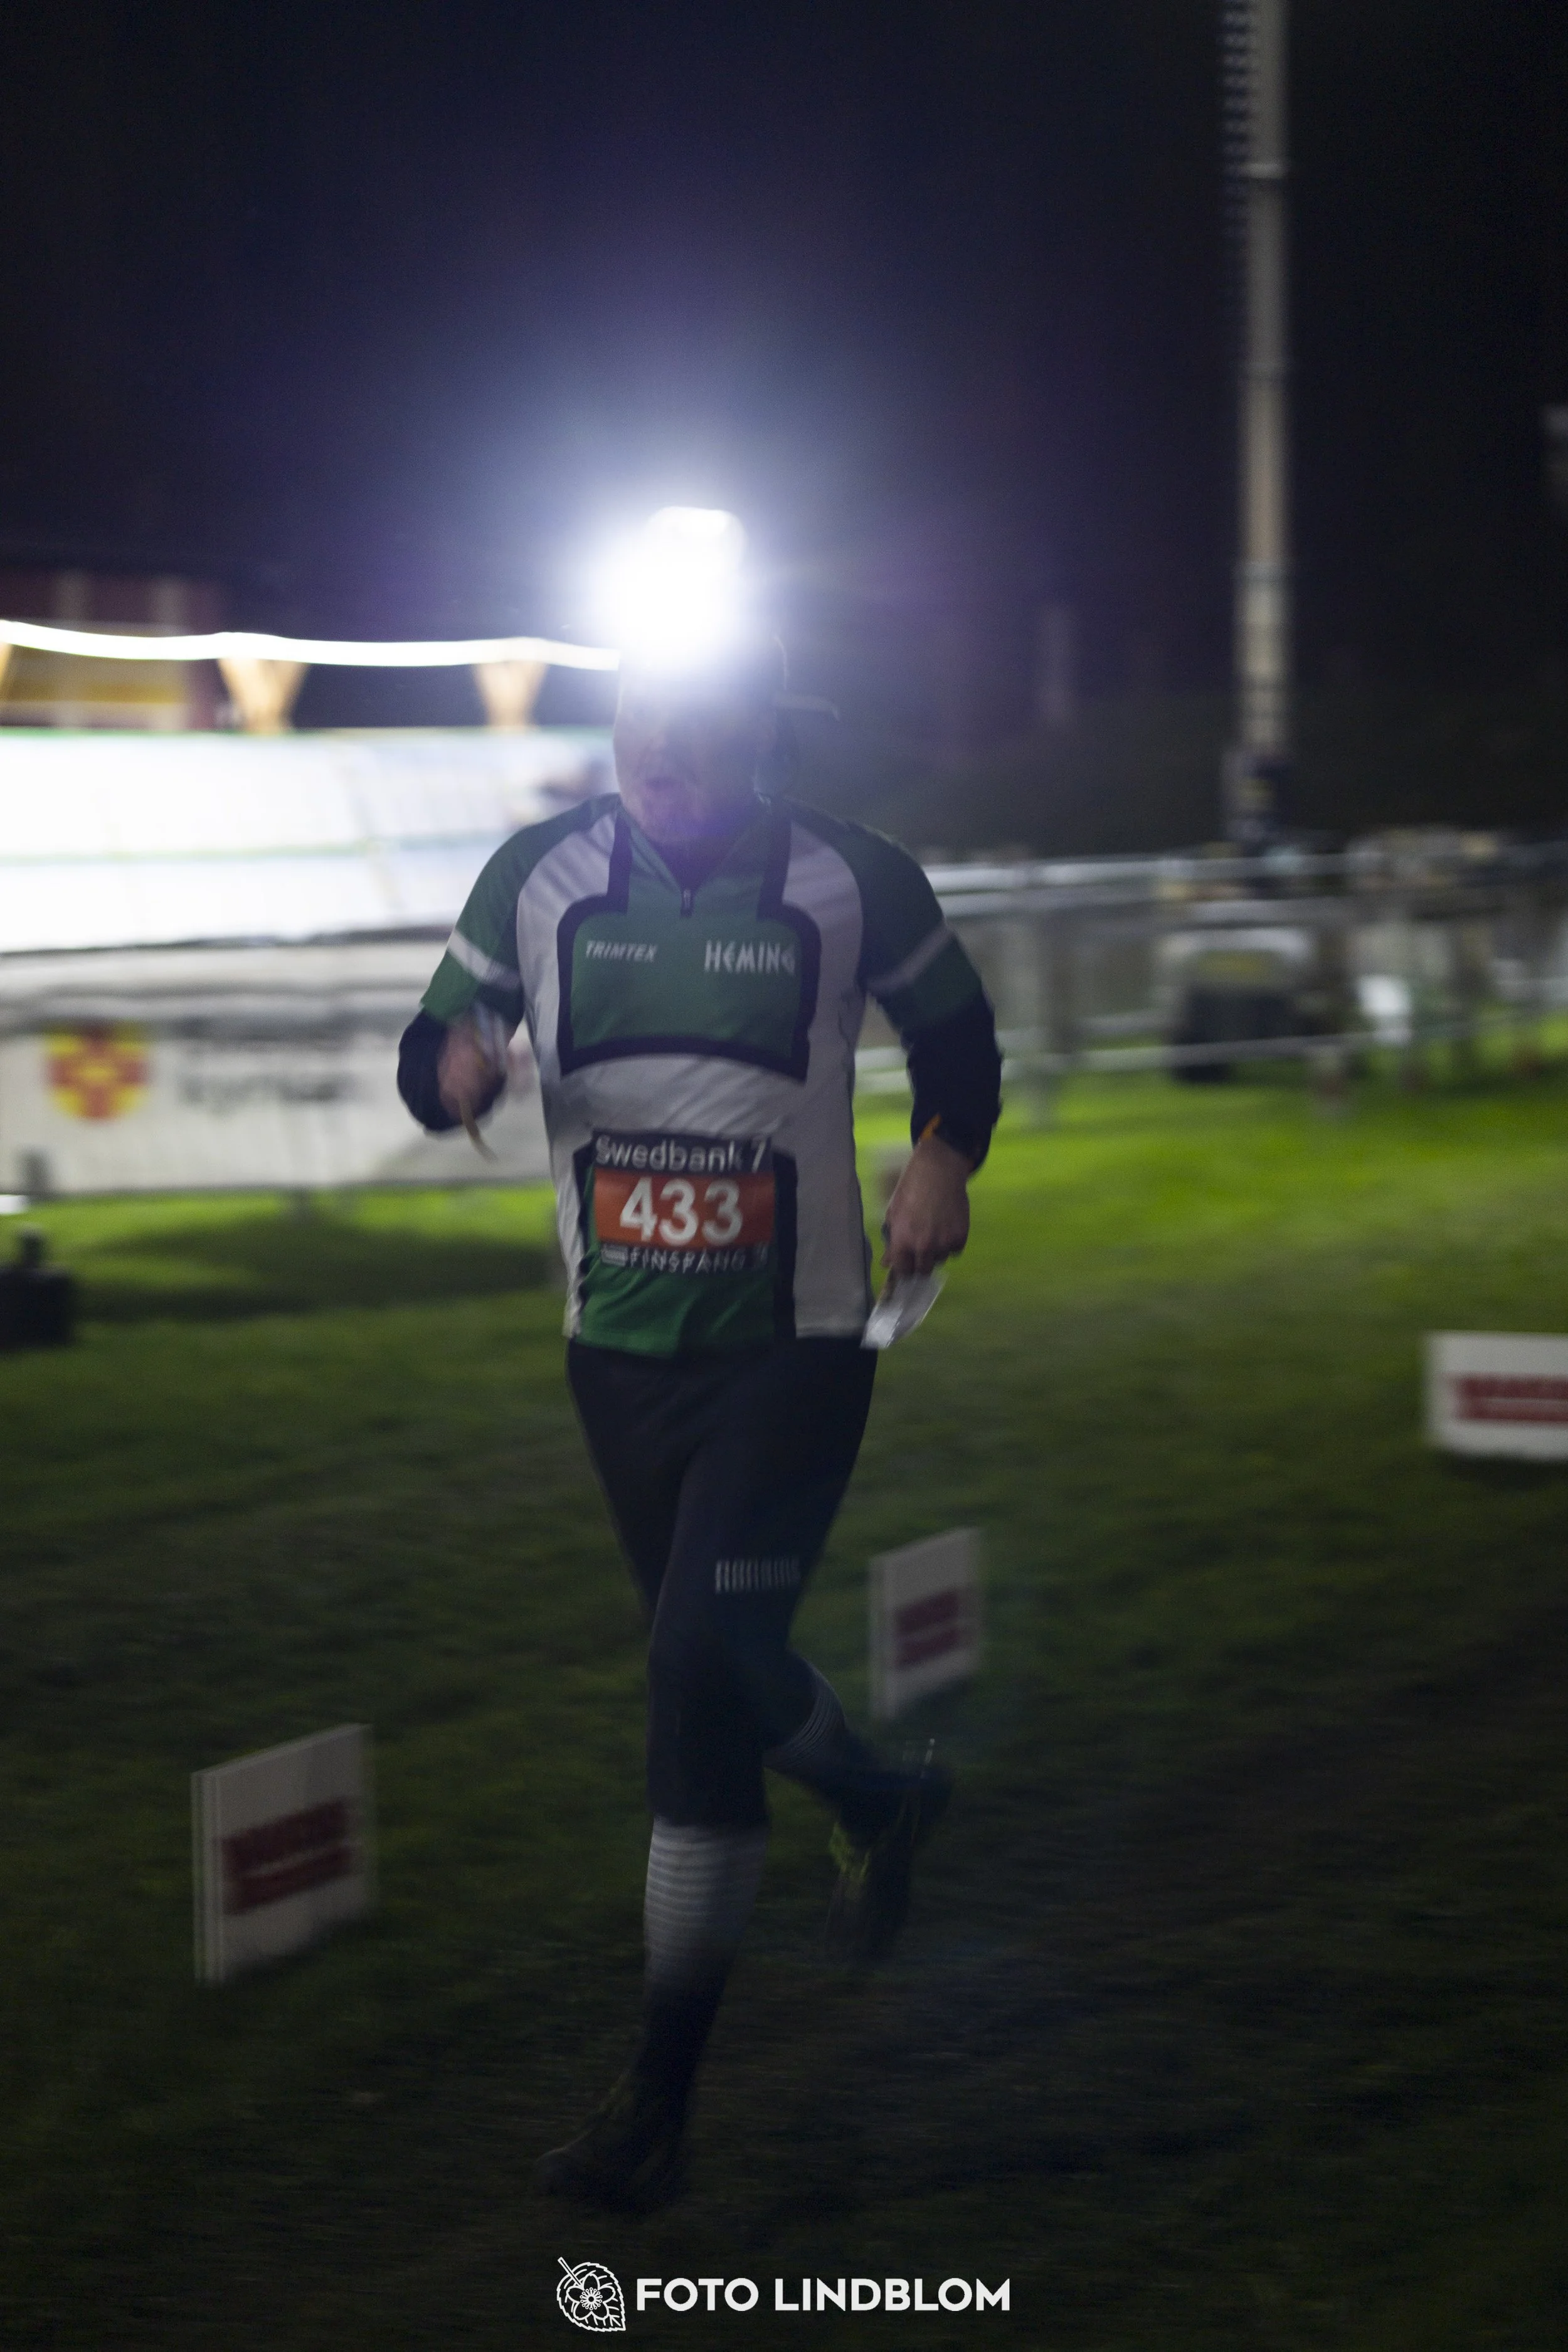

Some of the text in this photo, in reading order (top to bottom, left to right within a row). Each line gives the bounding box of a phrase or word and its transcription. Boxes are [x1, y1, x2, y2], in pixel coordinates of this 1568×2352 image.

[585, 940, 658, 963] TRIMTEX
[704, 940, 795, 975] HEMING
[595, 1135, 743, 1172] Swedbank
[619, 1177, 743, 1247] 433
